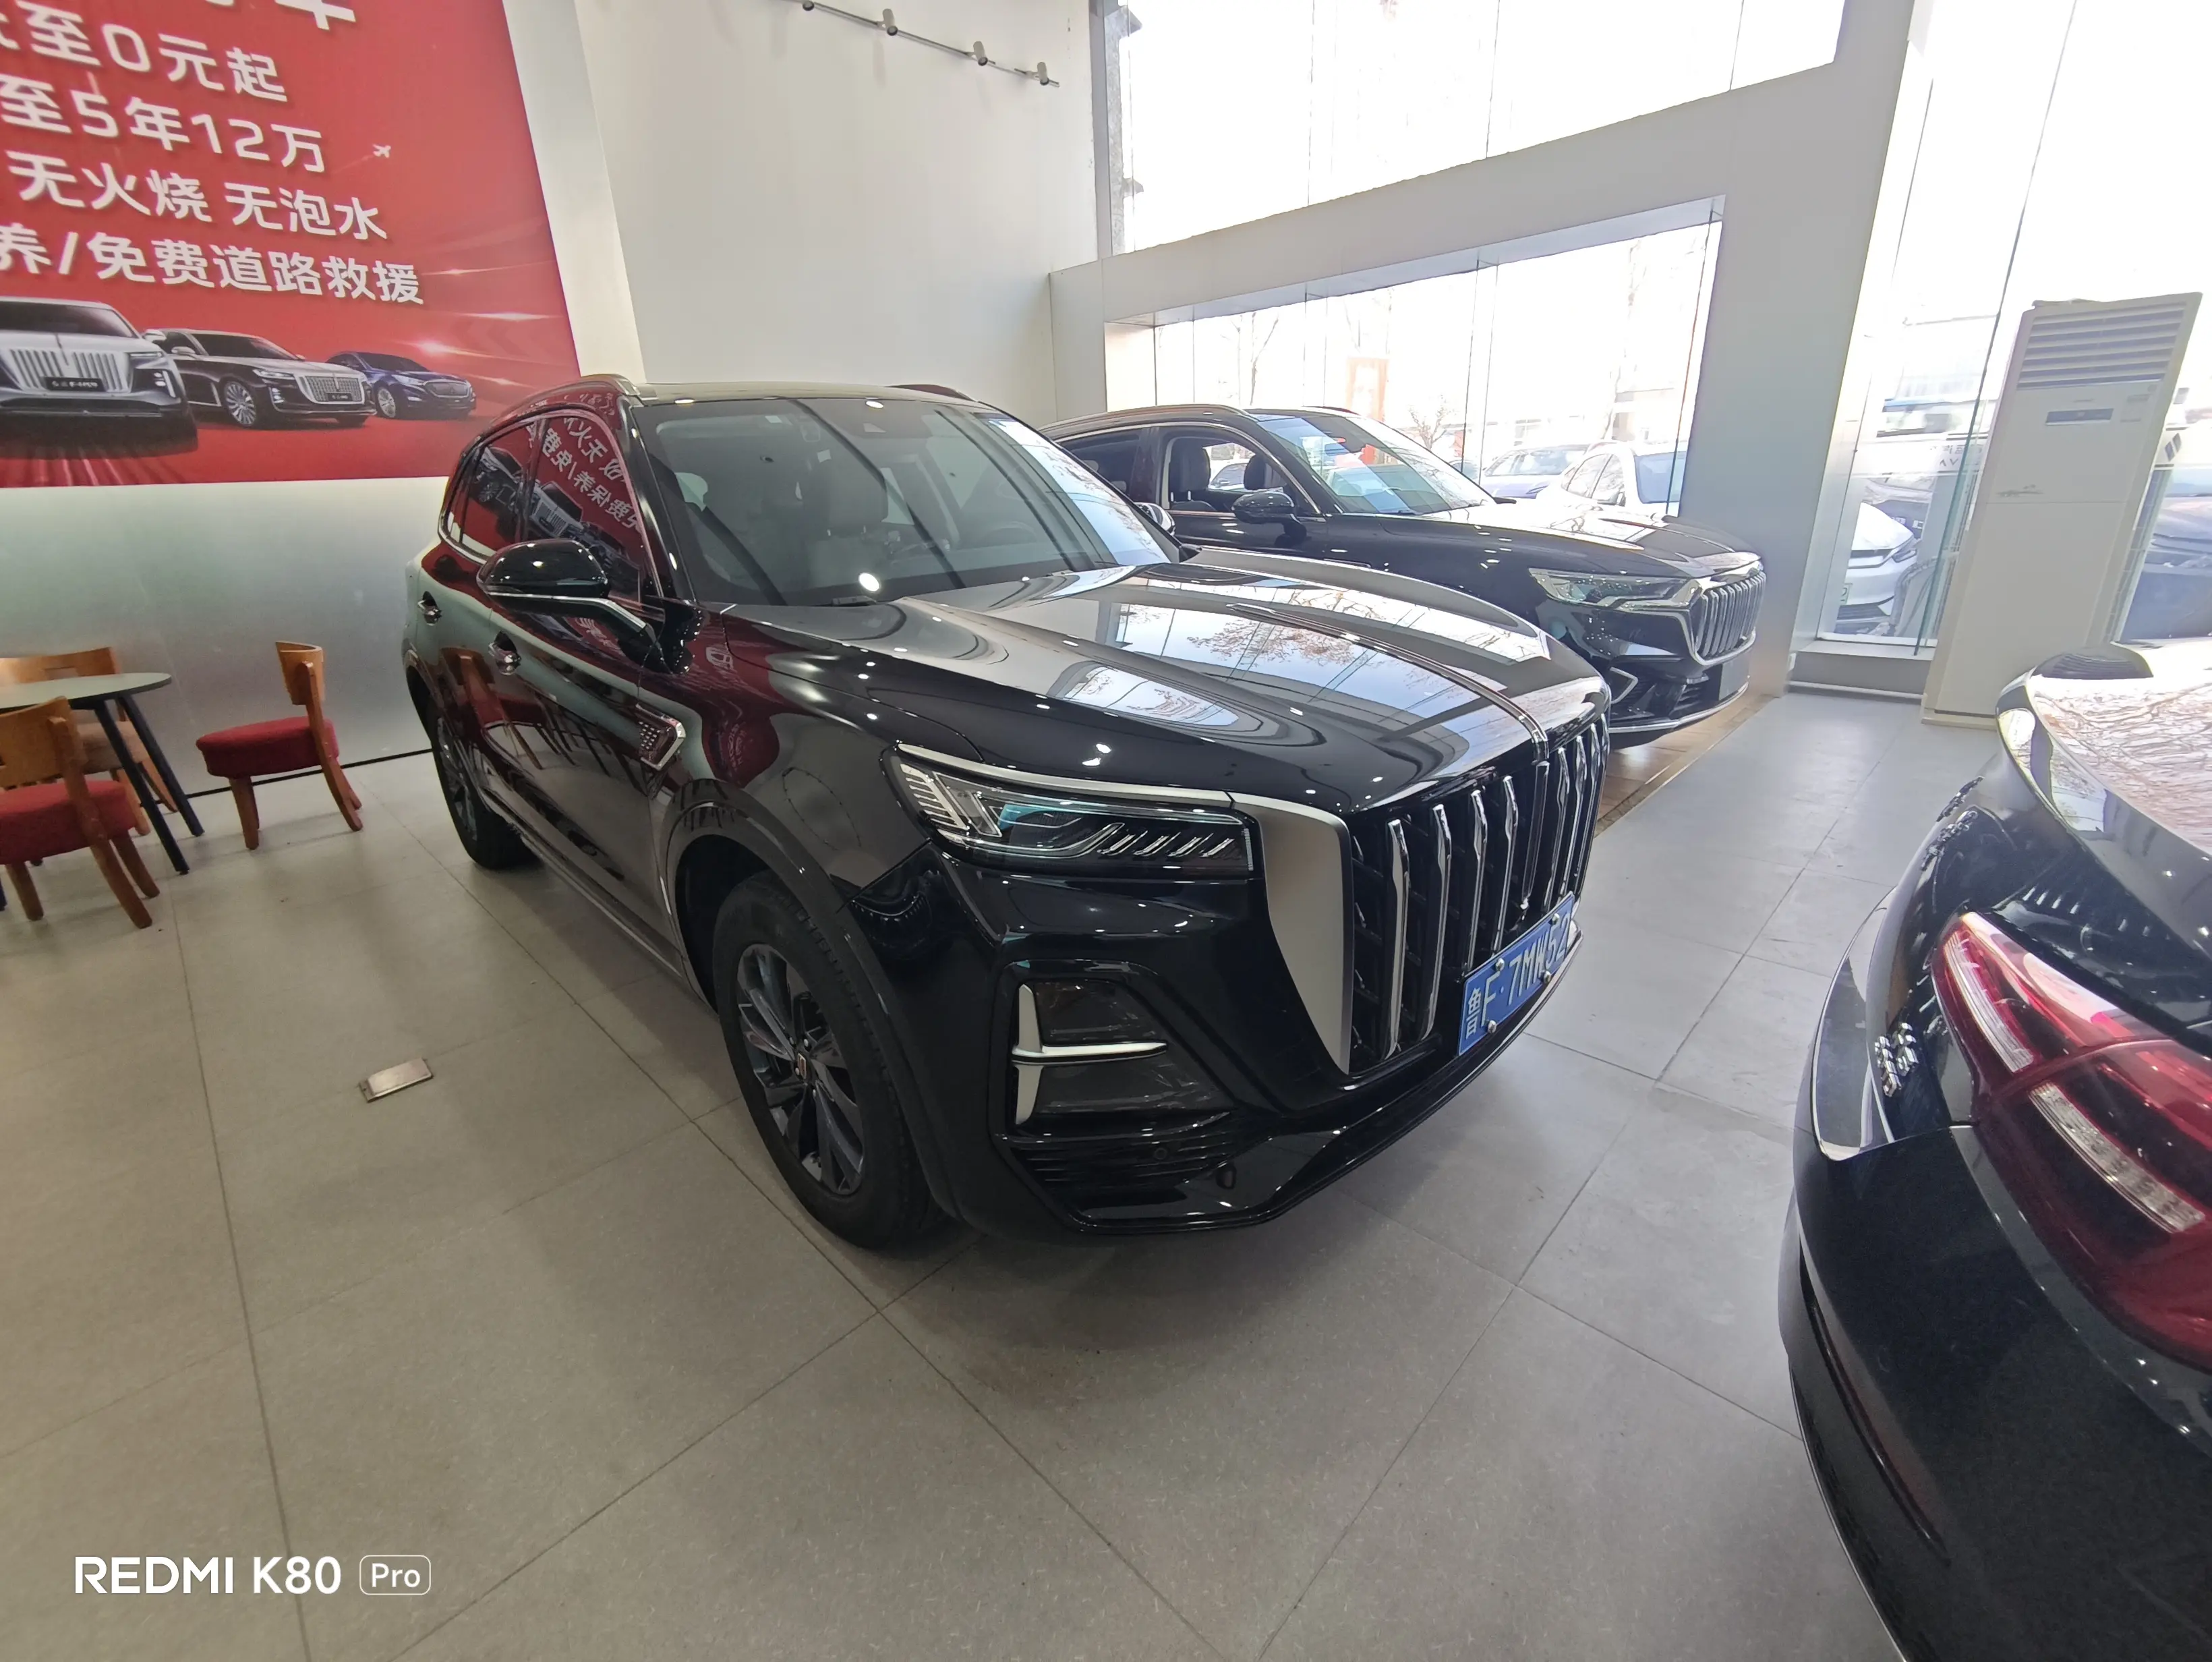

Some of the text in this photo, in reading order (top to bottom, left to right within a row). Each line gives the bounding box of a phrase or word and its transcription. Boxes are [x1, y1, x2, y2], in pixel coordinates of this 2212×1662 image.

[5, 150, 389, 241] 无火烧 无泡水
